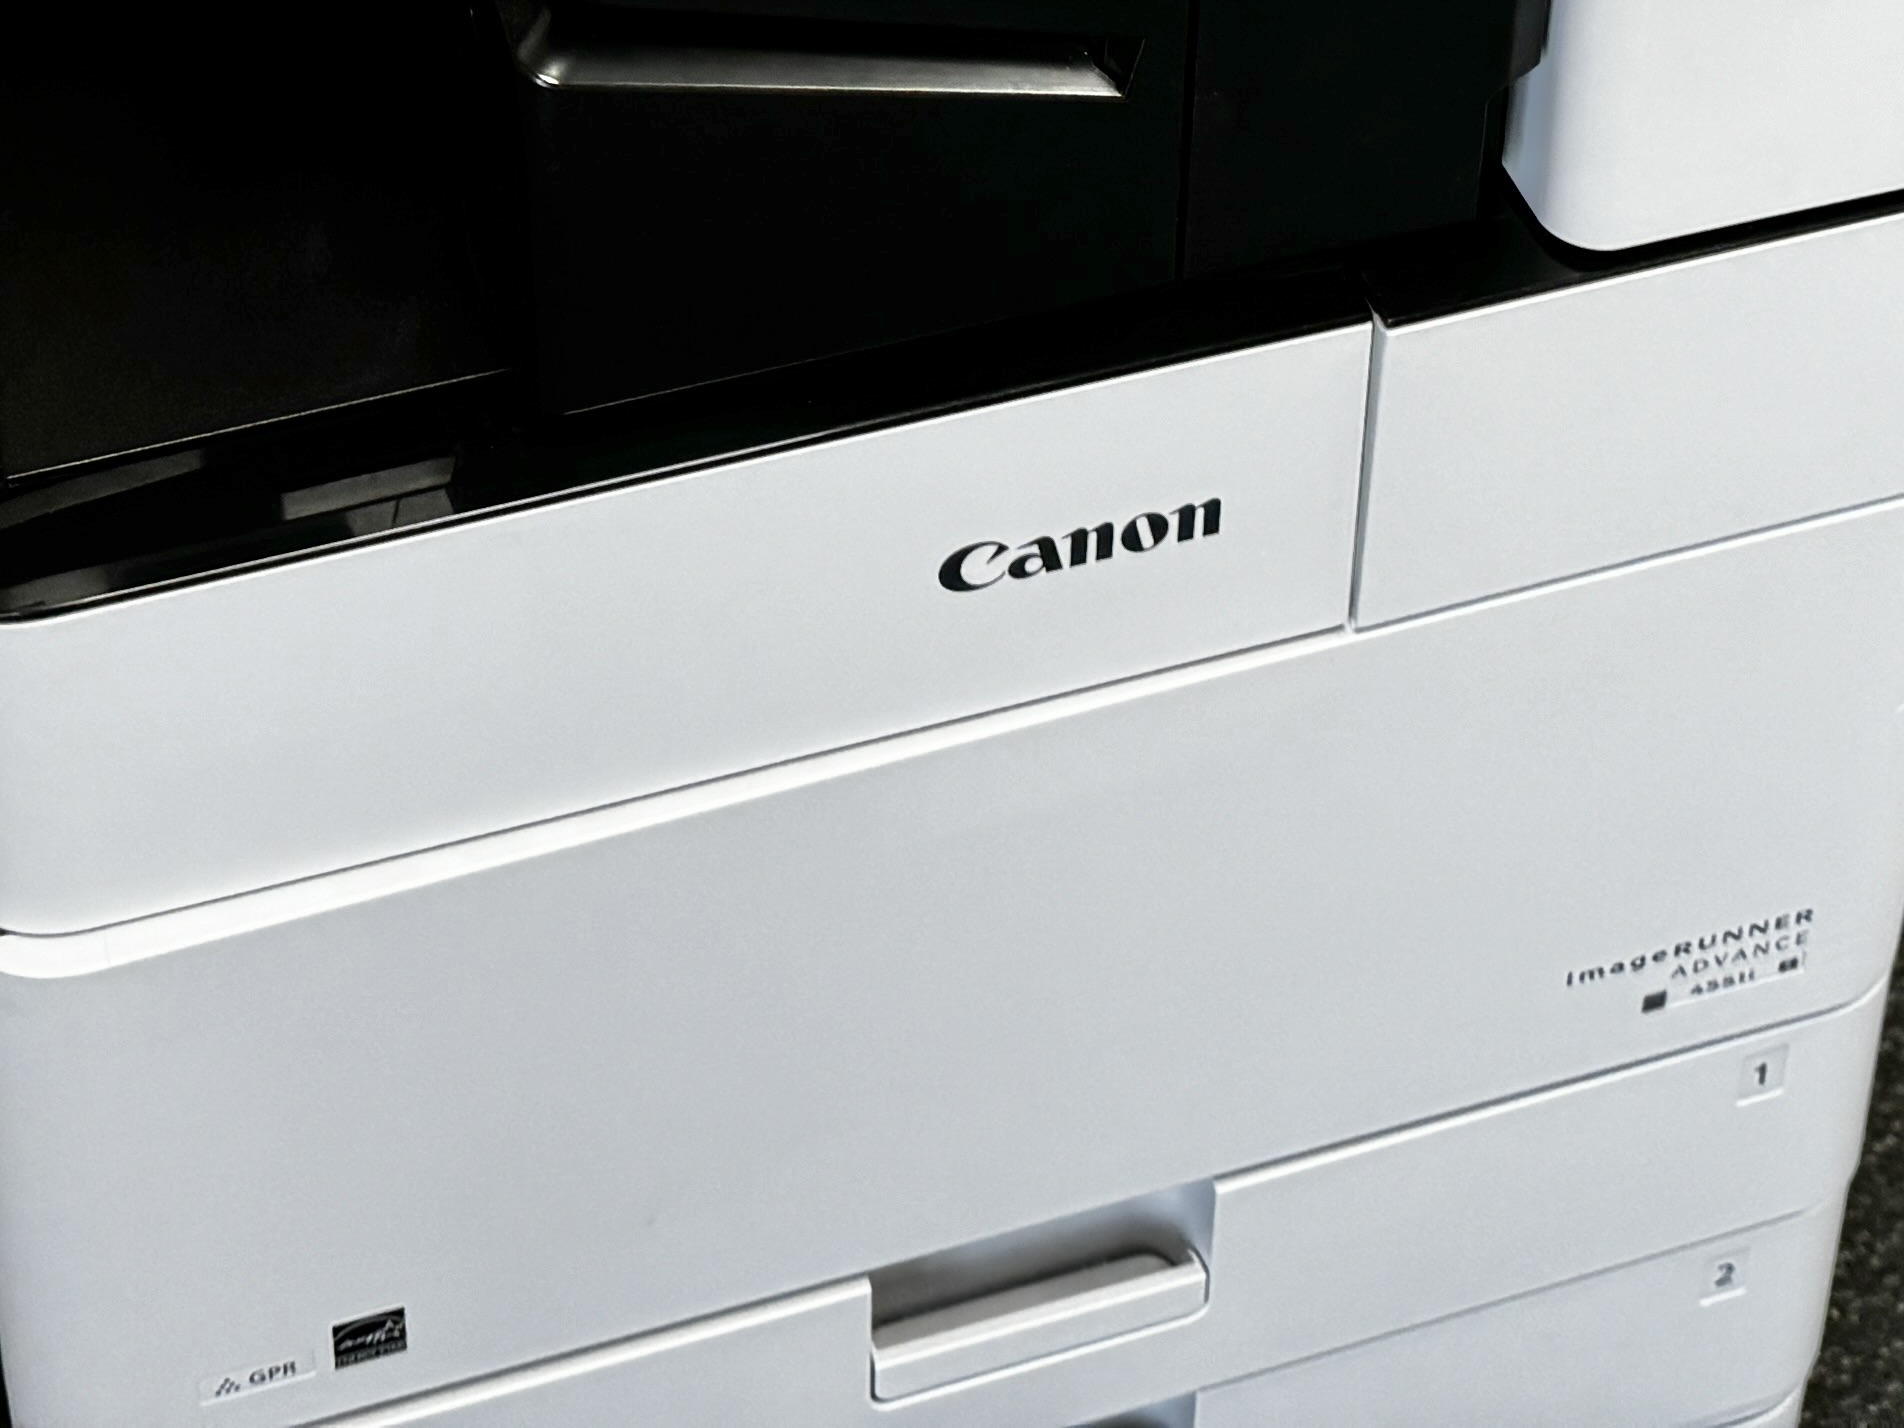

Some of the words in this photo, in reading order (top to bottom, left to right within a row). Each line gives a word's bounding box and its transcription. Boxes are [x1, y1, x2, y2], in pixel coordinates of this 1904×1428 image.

[938, 497, 1222, 592] Canon
[1671, 930, 1809, 980] ADVANCE
[1755, 1061, 1768, 1086] 1
[1714, 1262, 1736, 1287] 2
